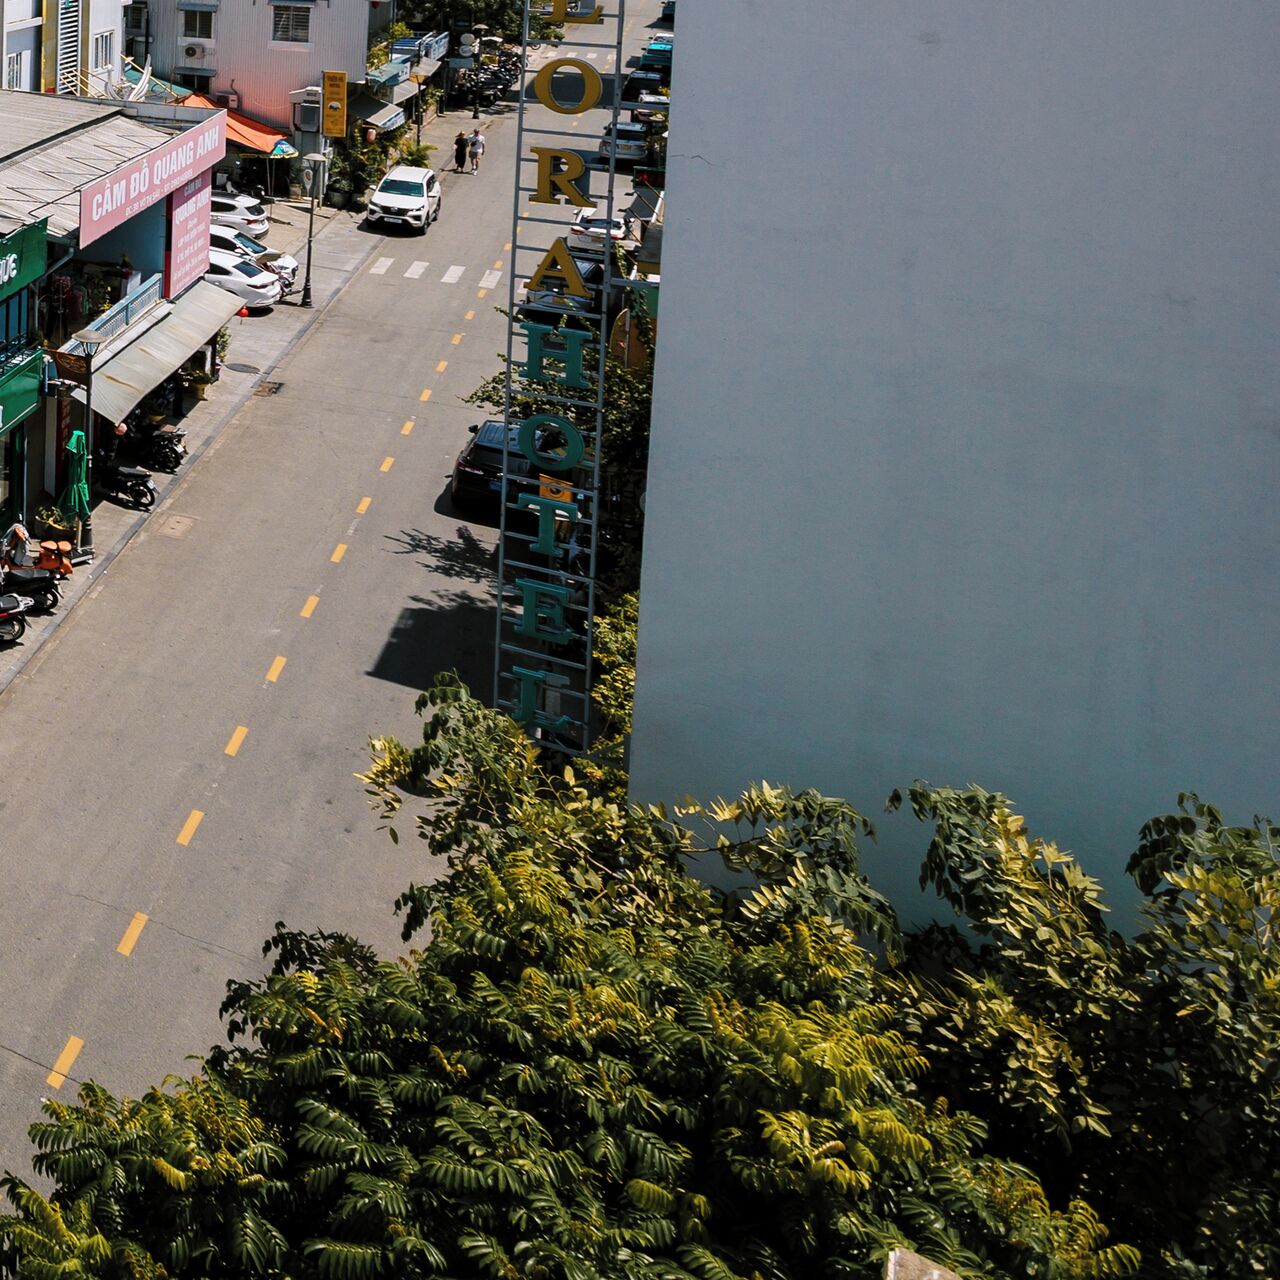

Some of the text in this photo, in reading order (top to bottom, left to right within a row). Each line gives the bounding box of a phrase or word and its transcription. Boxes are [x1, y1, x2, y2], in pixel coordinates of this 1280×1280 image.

[92, 179, 127, 221] CẦM
[130, 160, 150, 200] ĐỒ
[153, 141, 194, 185] QUANG
[196, 125, 219, 160] ANH
[512, 323, 592, 732] HOTEL
